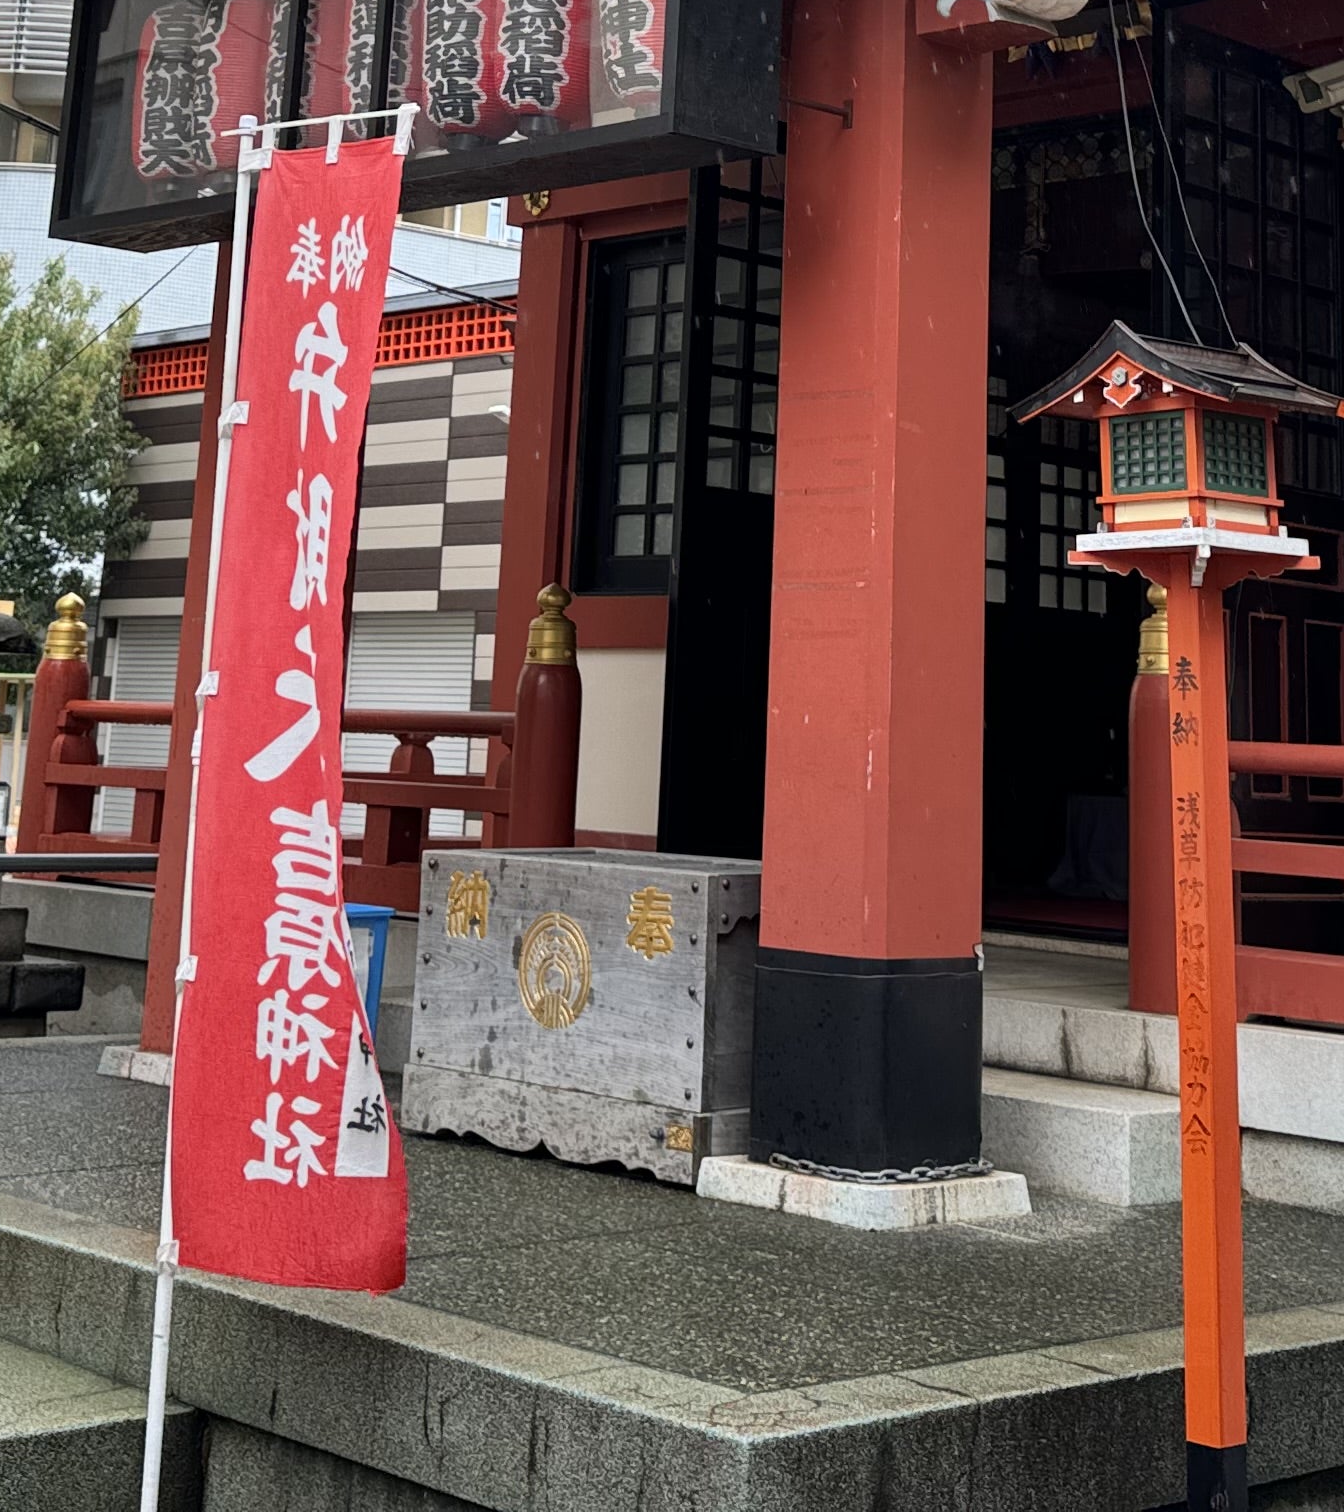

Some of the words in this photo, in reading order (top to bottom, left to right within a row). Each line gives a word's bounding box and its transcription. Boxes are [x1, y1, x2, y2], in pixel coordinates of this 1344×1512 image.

[1171, 655, 1200, 747] 奉納
[446, 870, 491, 940] 納
[625, 885, 675, 960] 奉
